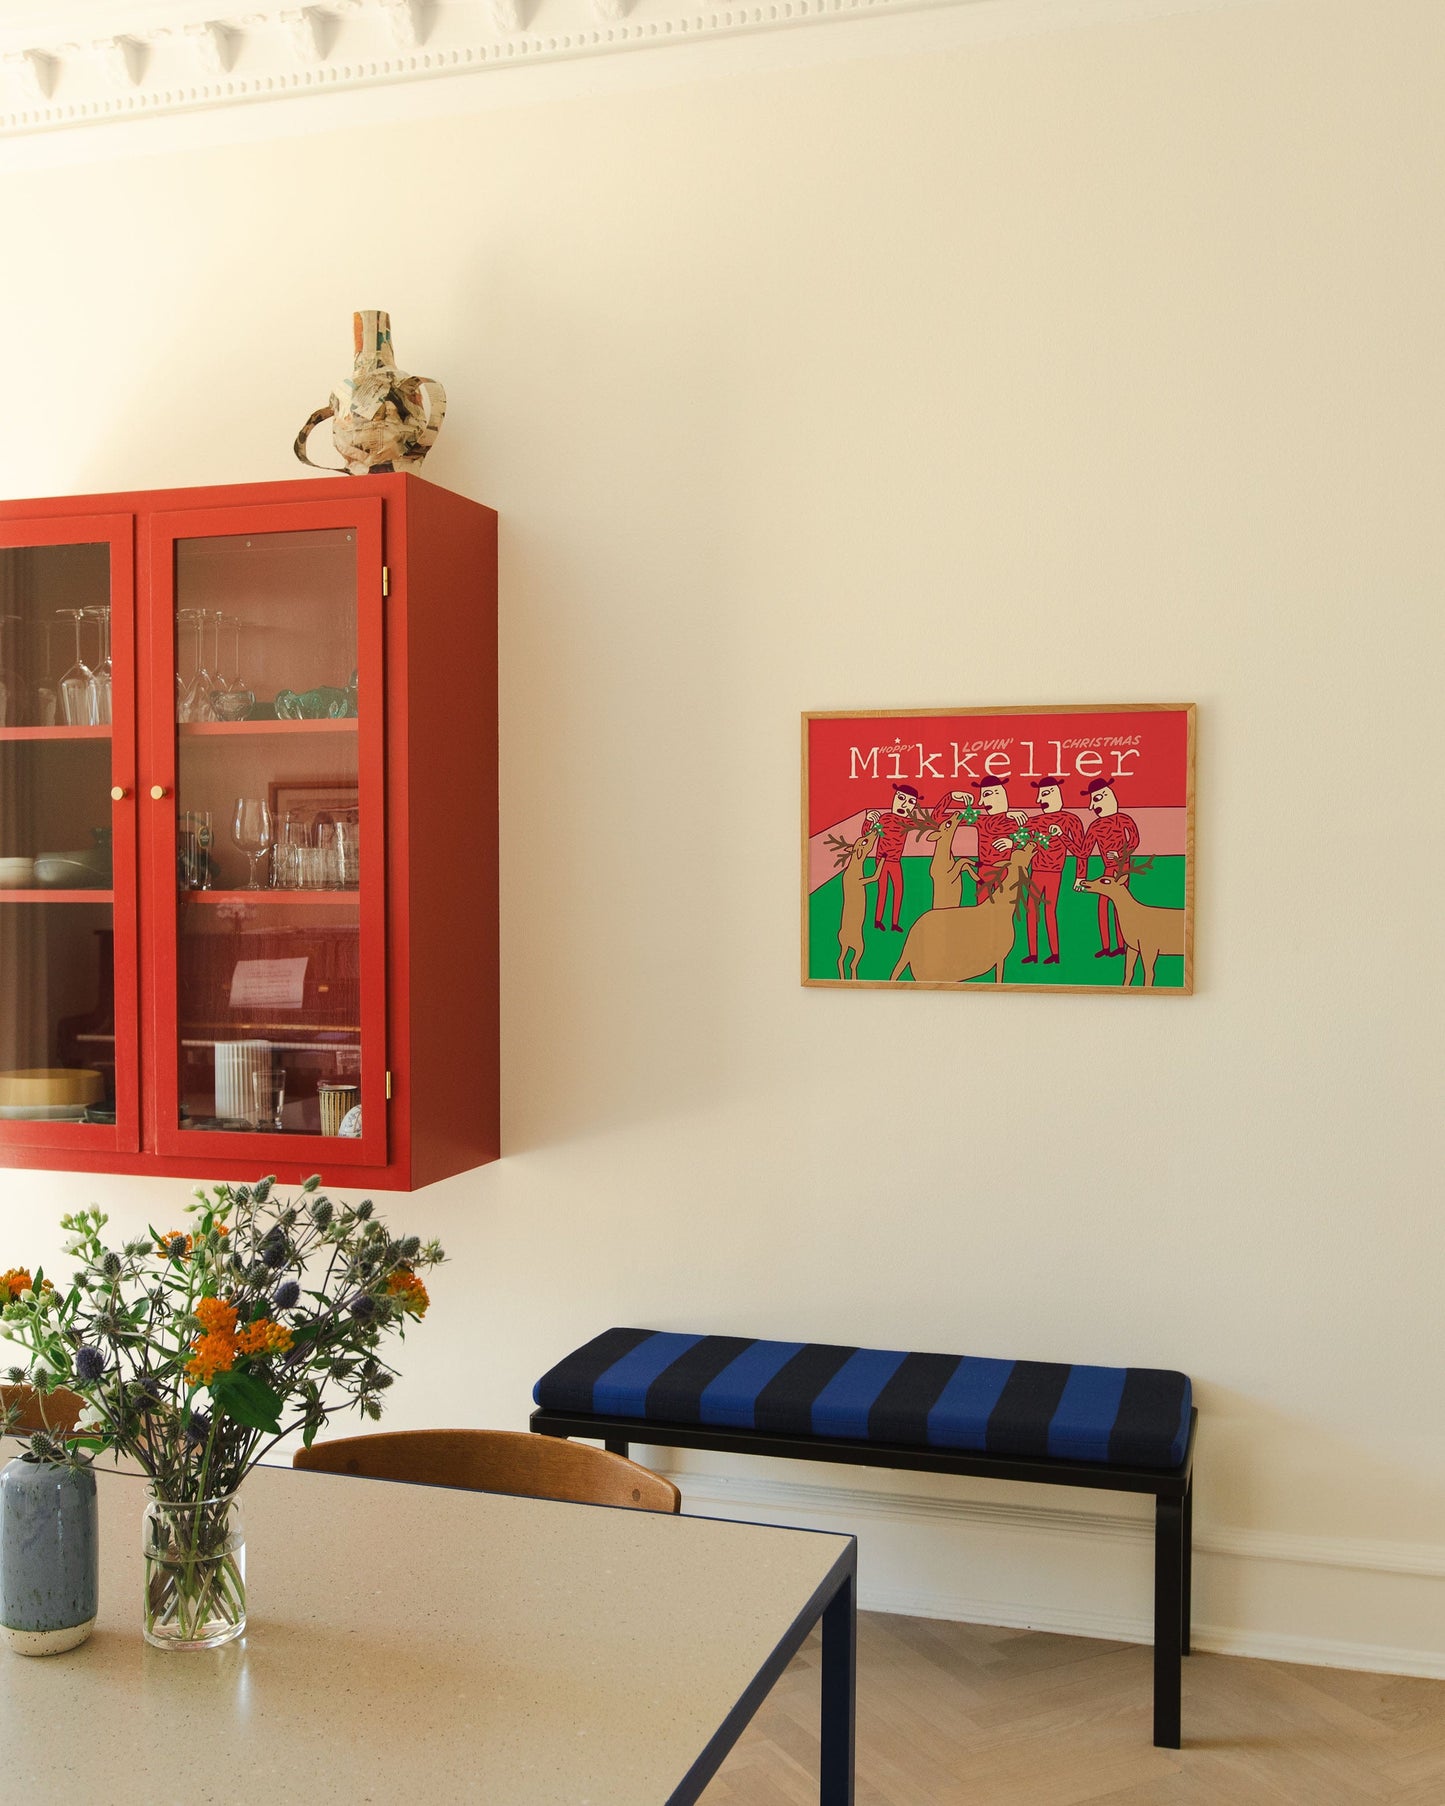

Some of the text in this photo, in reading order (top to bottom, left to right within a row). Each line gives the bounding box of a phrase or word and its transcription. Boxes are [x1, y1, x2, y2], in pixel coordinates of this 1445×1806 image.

[848, 737, 1141, 779] Mikkeller
[878, 735, 1142, 754] HOPPY LOVIN' CHRISTMAS
